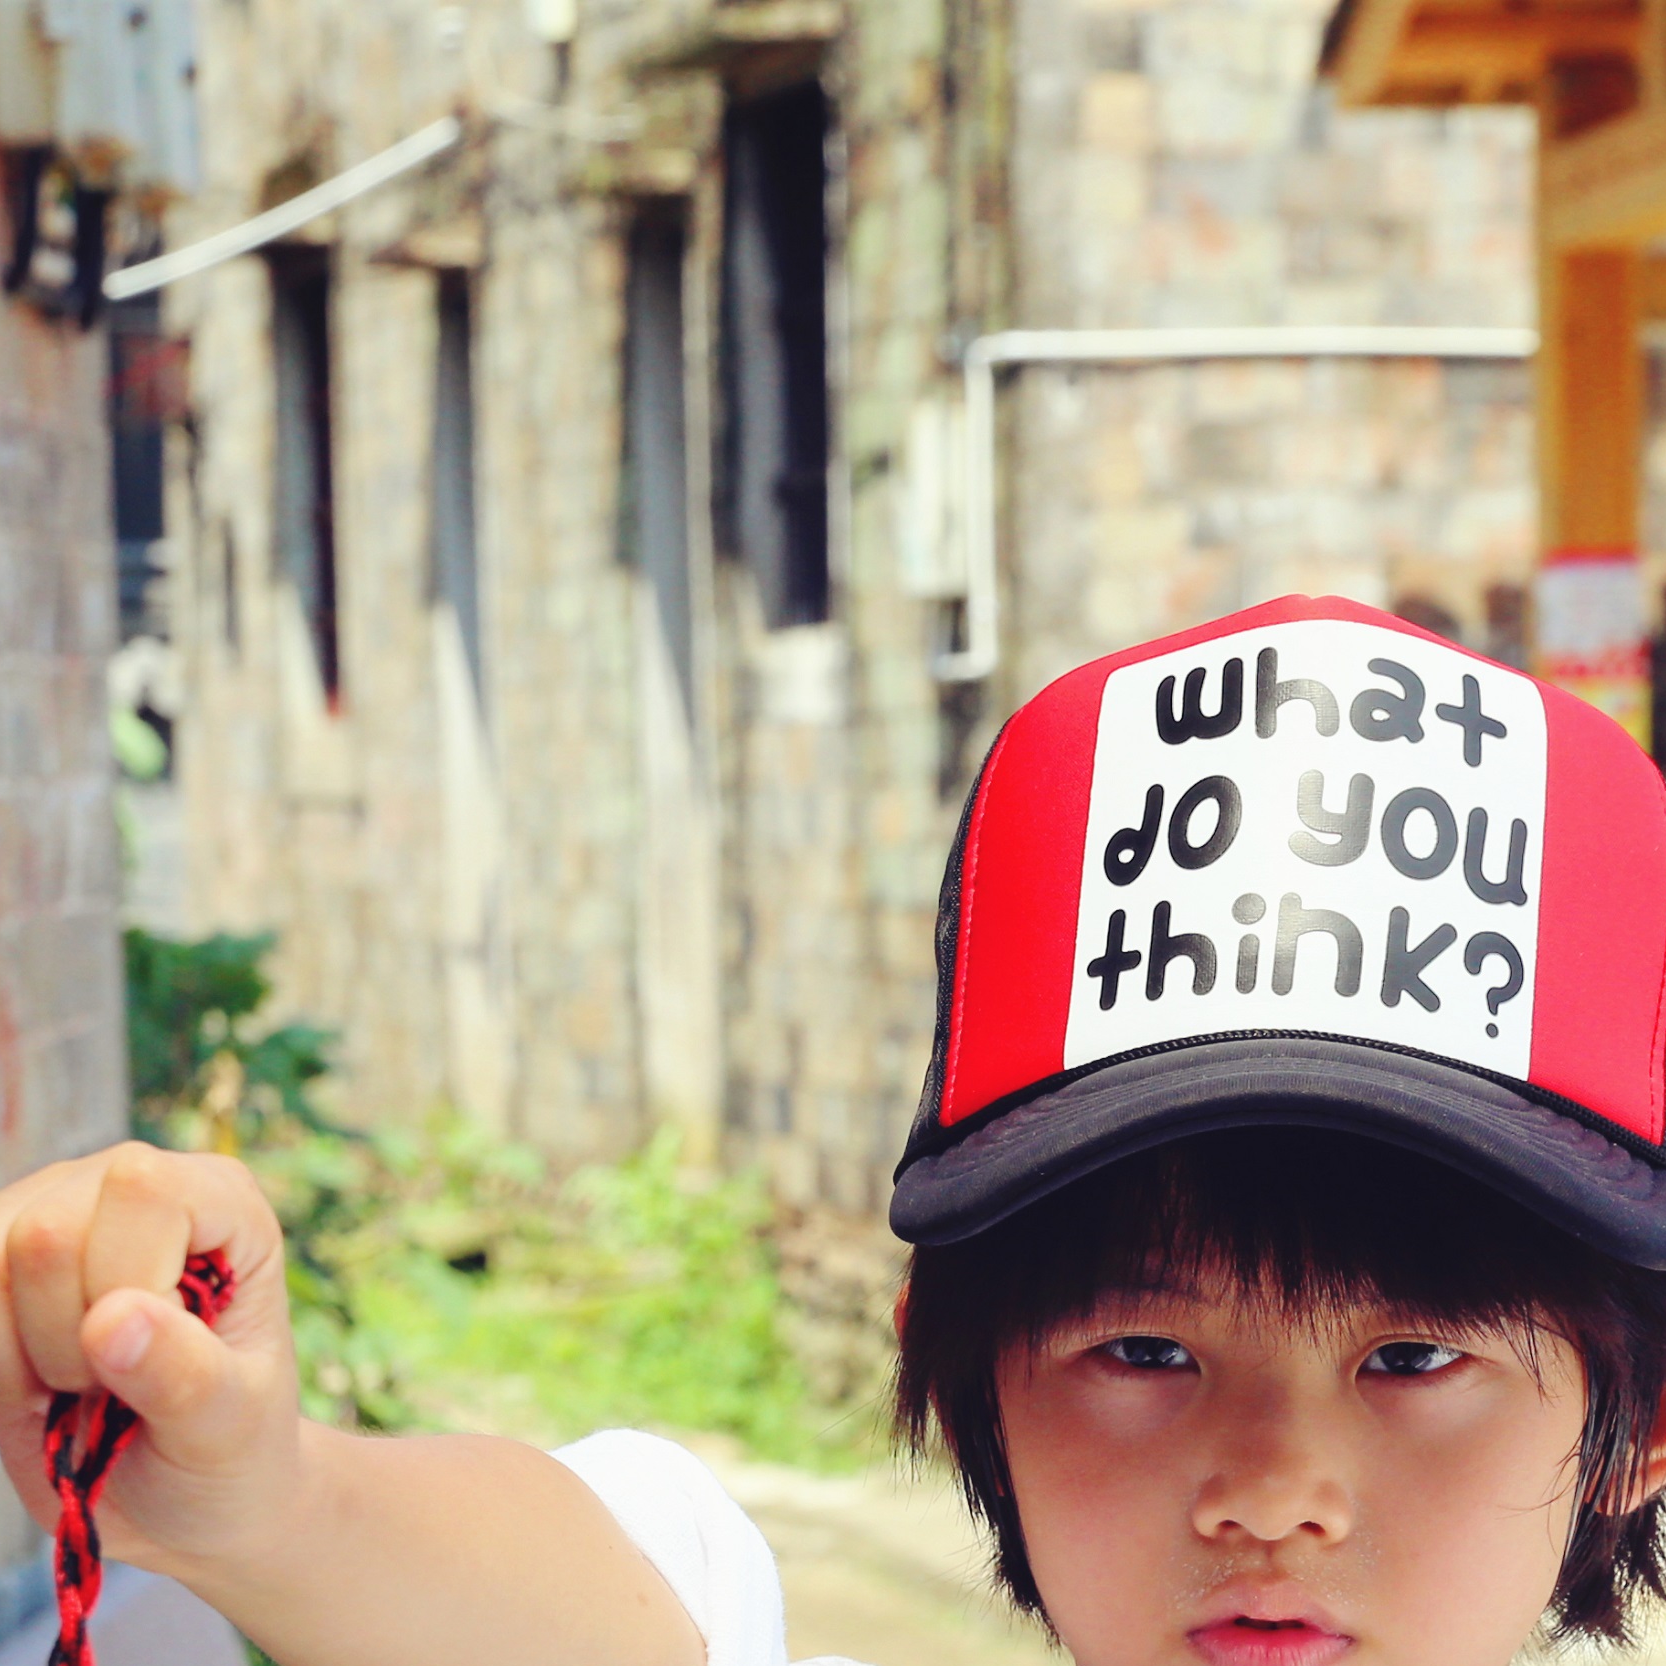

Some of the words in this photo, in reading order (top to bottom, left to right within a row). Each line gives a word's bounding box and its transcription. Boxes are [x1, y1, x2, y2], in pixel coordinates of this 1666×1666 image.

[1156, 646, 1508, 768] what
[1103, 774, 1243, 887] do
[1287, 769, 1529, 907] you
[1085, 891, 1526, 1039] think?
